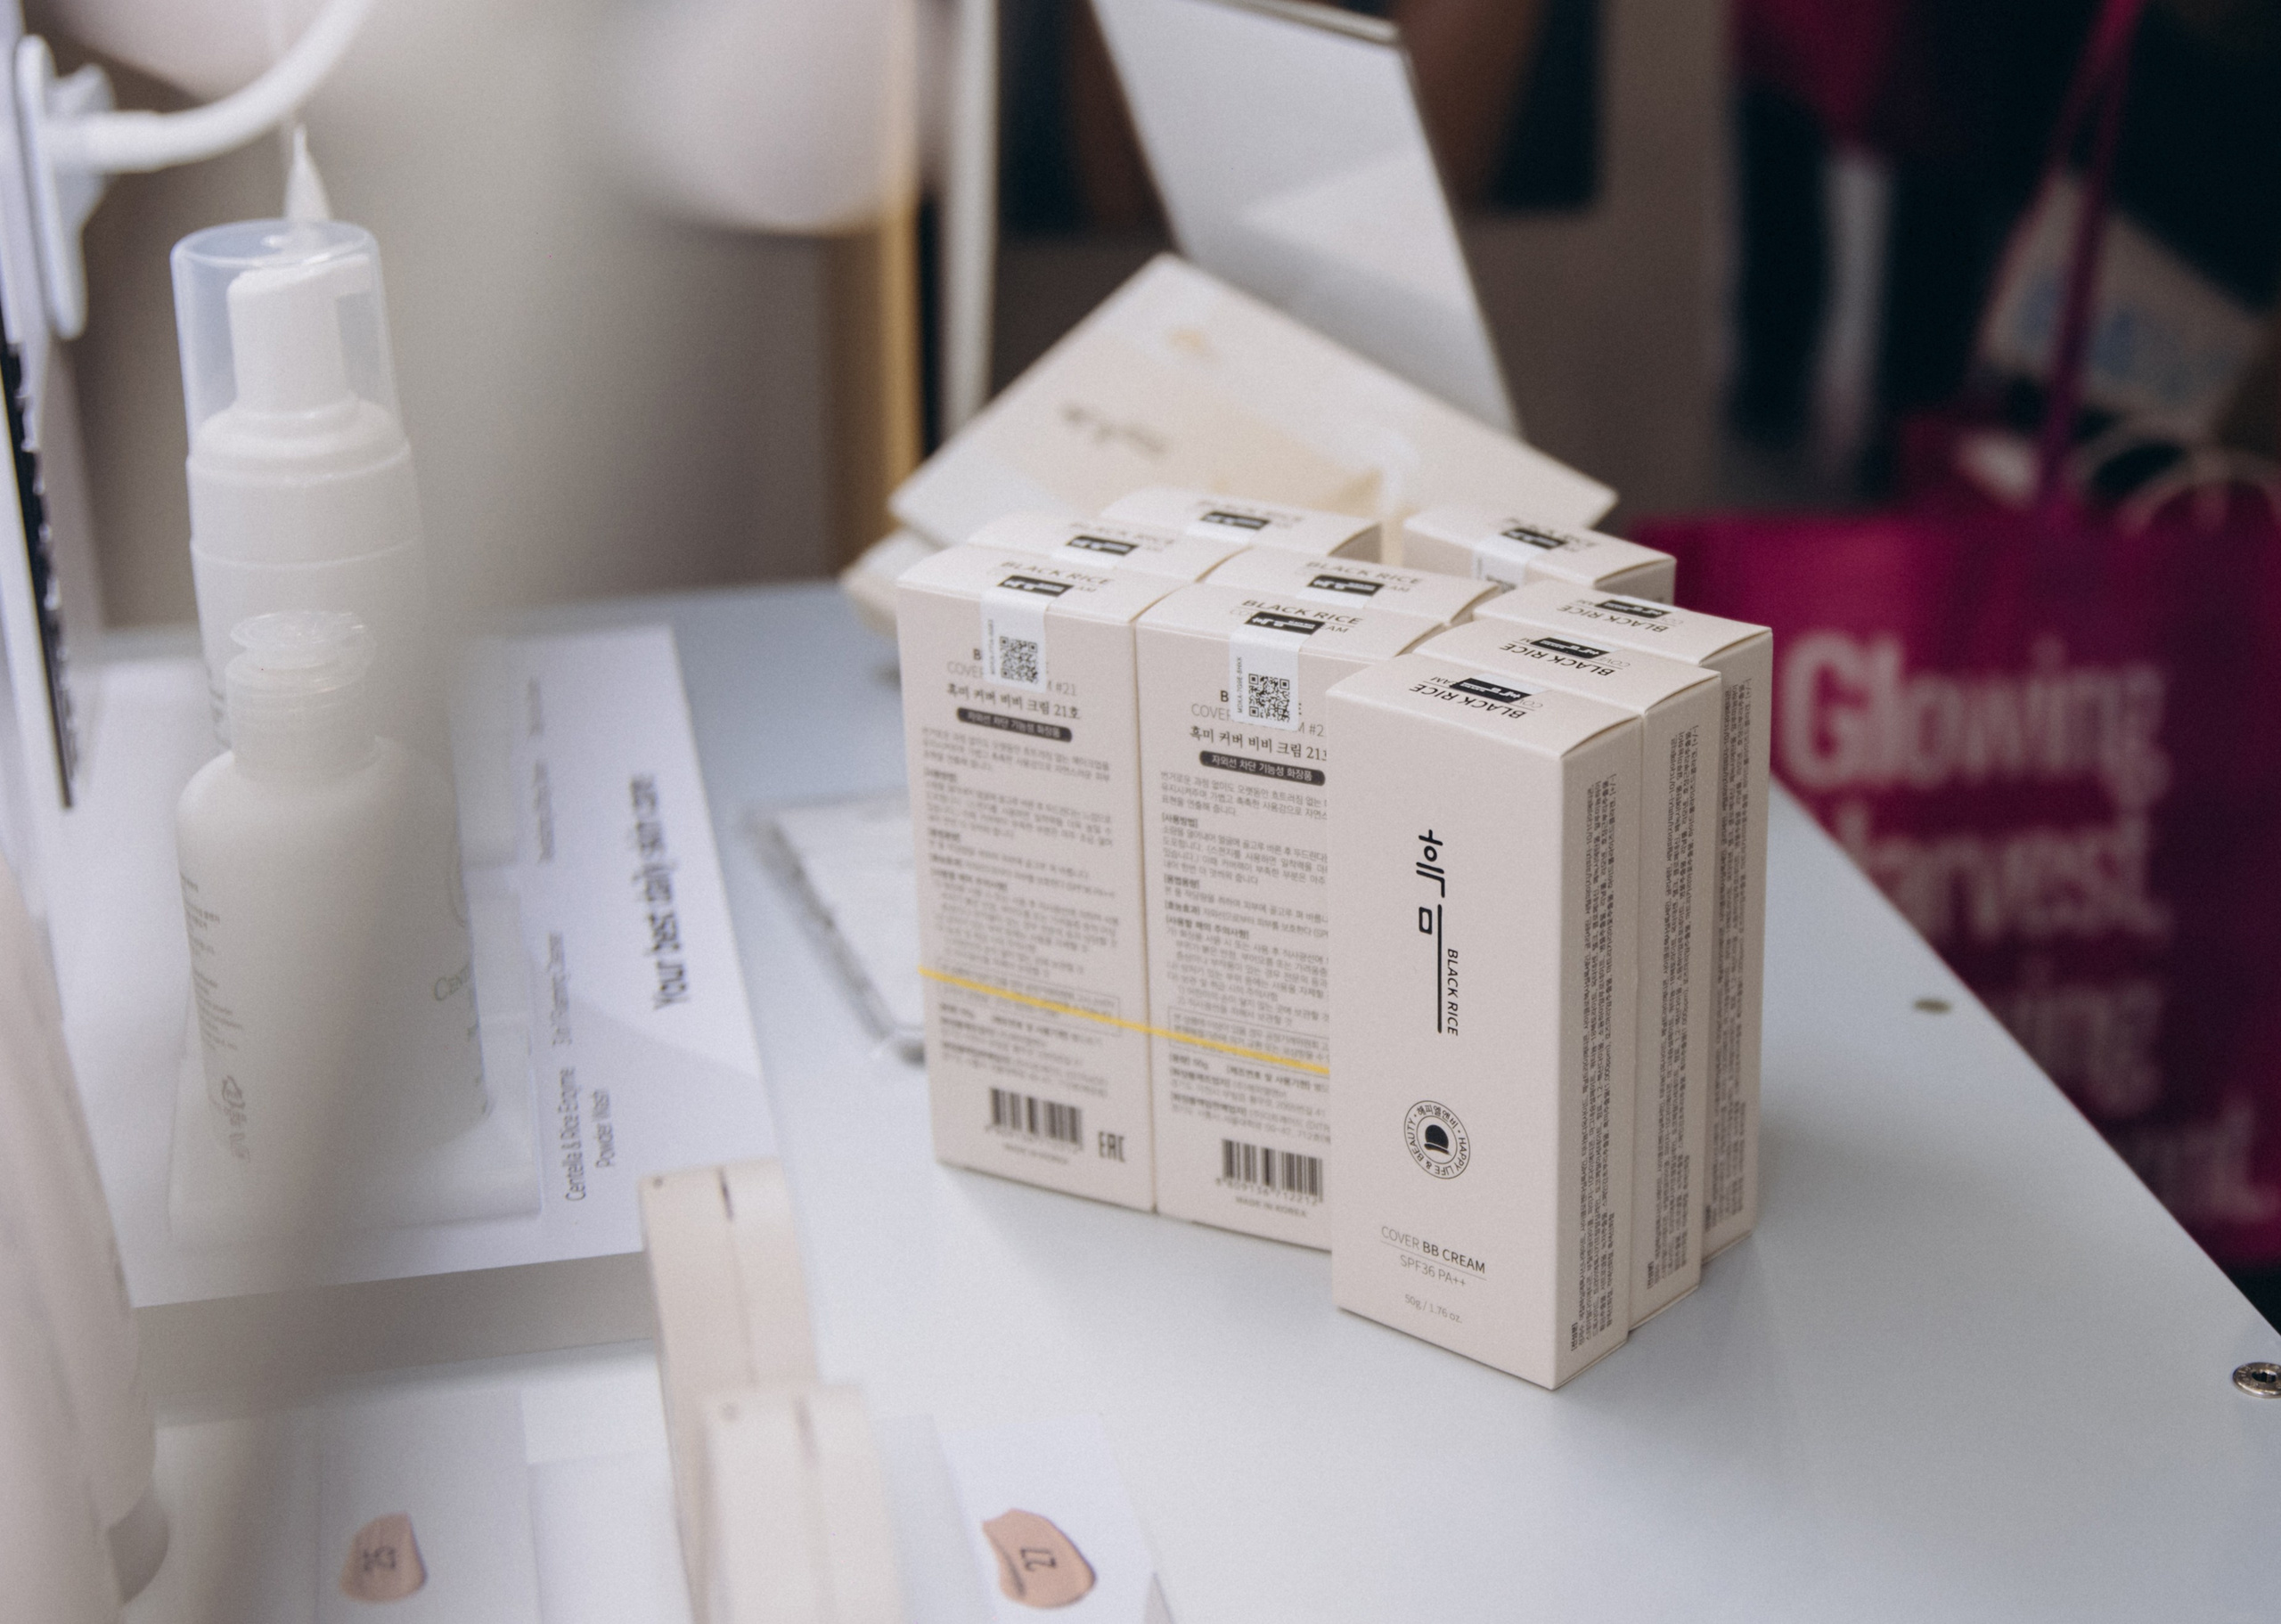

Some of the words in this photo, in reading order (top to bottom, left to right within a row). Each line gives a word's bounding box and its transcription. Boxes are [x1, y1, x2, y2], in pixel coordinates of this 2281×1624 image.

[1242, 600, 1312, 616] BLACK
[1313, 611, 1363, 624] RICE
[1557, 605, 1604, 618] RICE
[1604, 616, 1669, 632] BLACK
[1499, 642, 1549, 659] RICE
[1547, 655, 1615, 676] BLACK
[1409, 683, 1459, 701] RICE
[1458, 696, 1527, 719] BLACK
[1190, 725, 1214, 742] 흑미
[1219, 732, 1243, 748] 커버
[1248, 738, 1273, 753] 비비
[1276, 740, 1302, 758] 크림
[1212, 755, 1237, 769] 자외선
[1239, 758, 1256, 772] 차단
[1259, 763, 1284, 778] 기능성
[1287, 766, 1312, 782] 화장품
[642, 910, 684, 959] best
[654, 959, 689, 1010] Your
[1447, 949, 1459, 997] BLACK
[1447, 1000, 1459, 1036] RICE
[560, 1114, 581, 1140] Rice
[1416, 1104, 1459, 1129] 해피엘앤비
[593, 1124, 616, 1169] Powder
[1407, 1117, 1425, 1162] BEAUTY
[1454, 1137, 1467, 1171] HAPPY
[564, 1152, 586, 1202] Centella
[1435, 1164, 1455, 1176] LIFE
[1381, 1226, 1419, 1250] COVER
[1422, 1241, 1439, 1257] BB
[1443, 1249, 1485, 1274] CREAM
[1400, 1254, 1435, 1277] SPF36
[1438, 1269, 1466, 1286] PA++
[1021, 1546, 1058, 1571] 27
